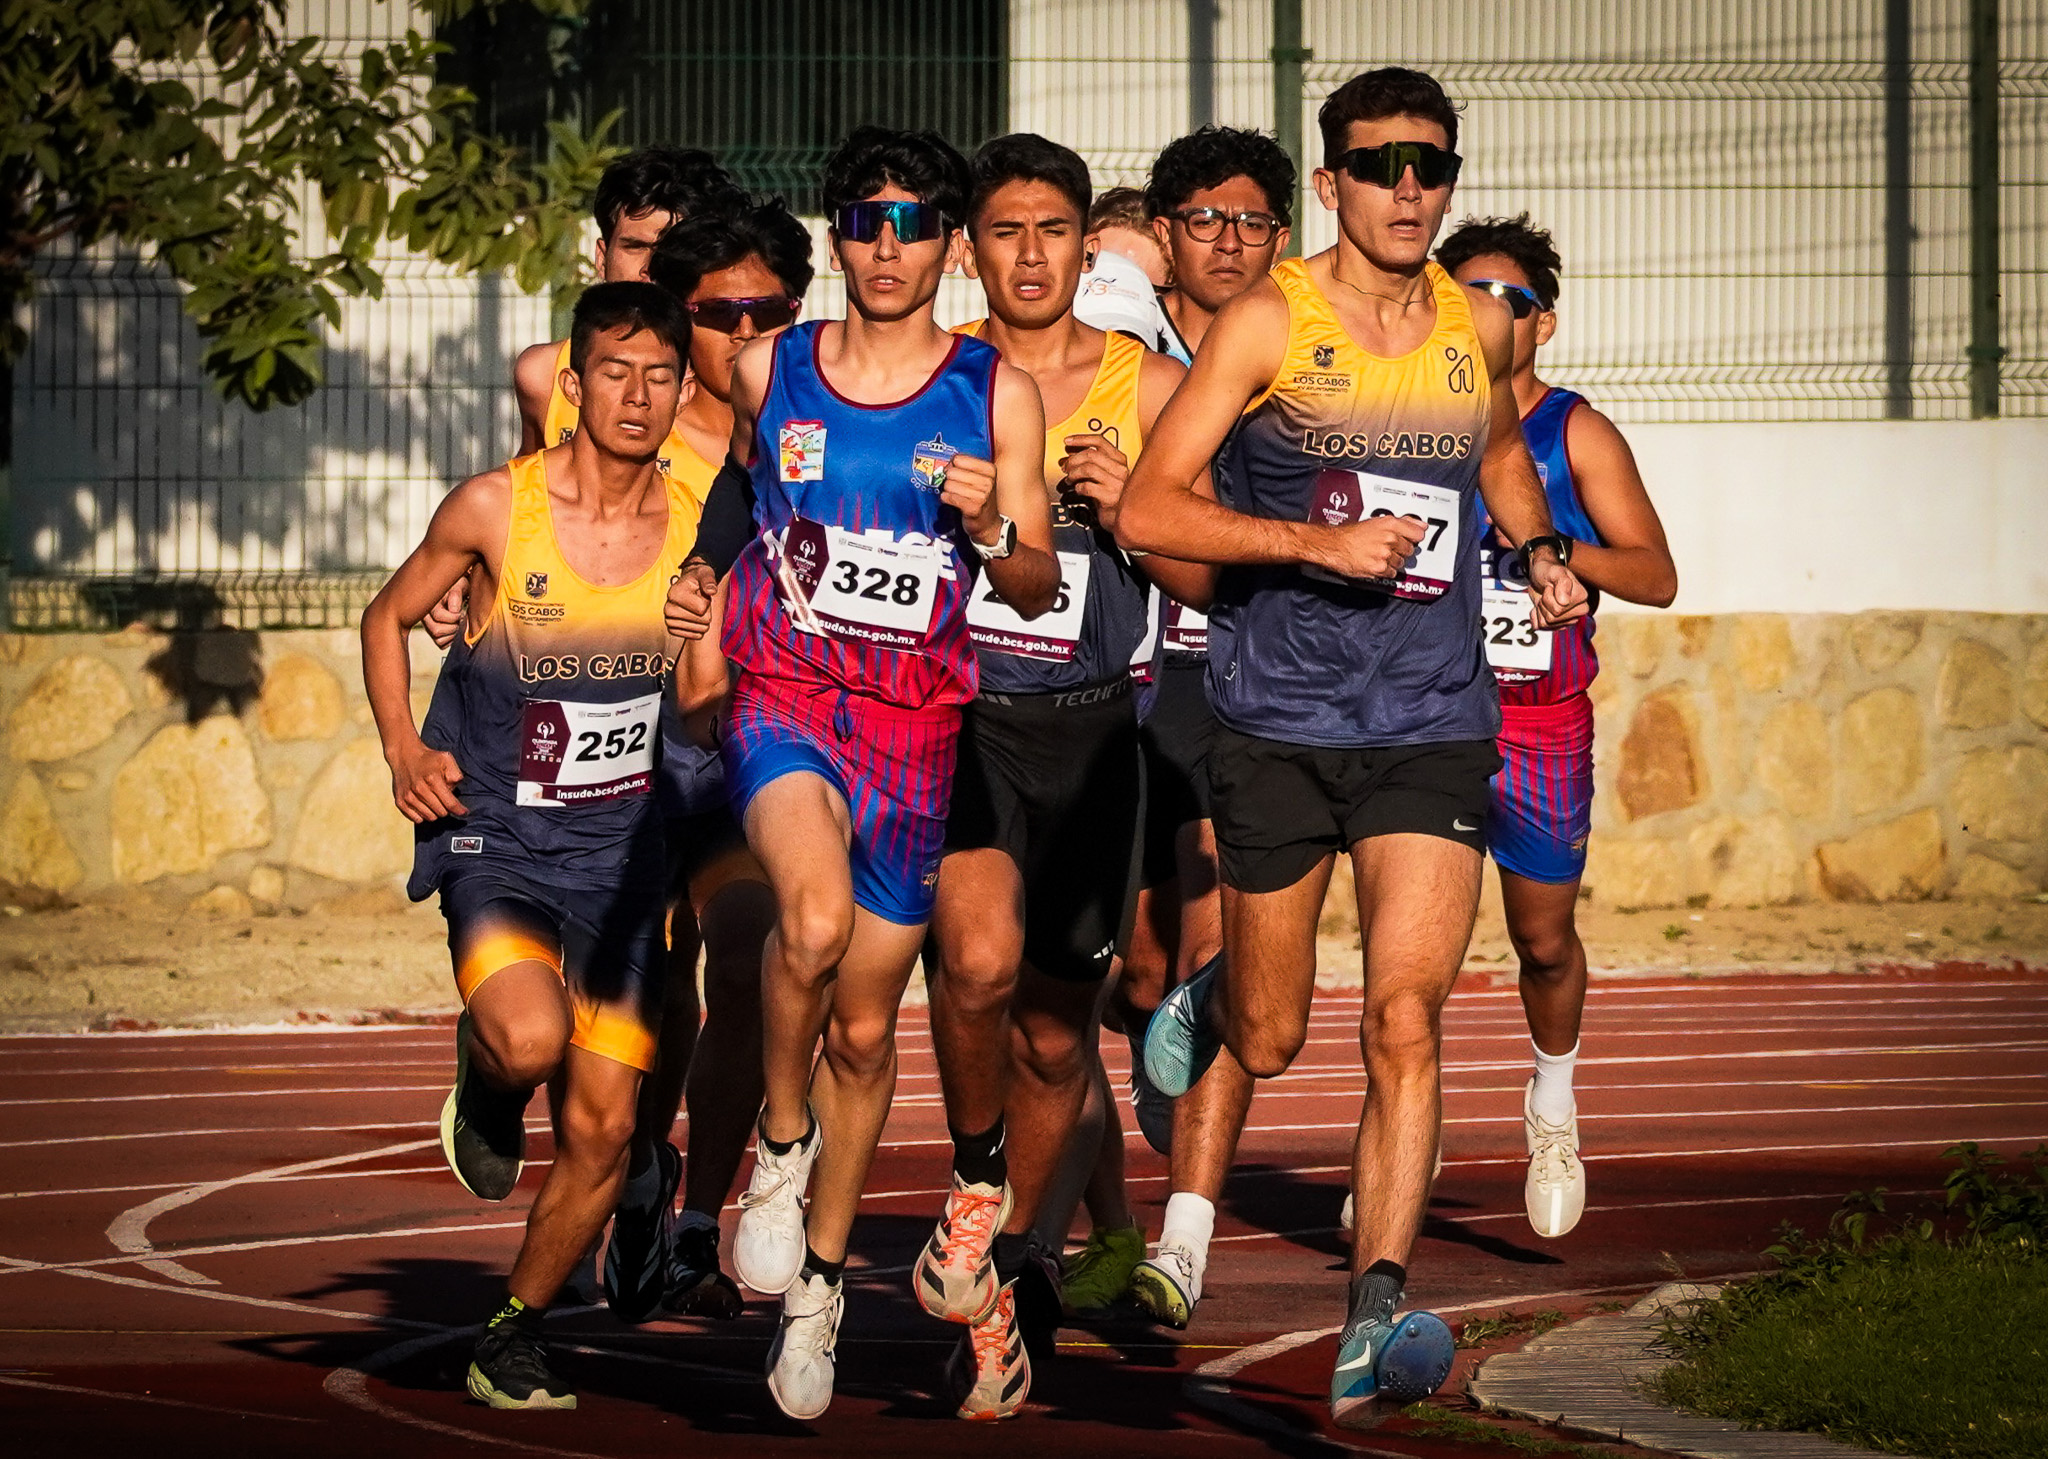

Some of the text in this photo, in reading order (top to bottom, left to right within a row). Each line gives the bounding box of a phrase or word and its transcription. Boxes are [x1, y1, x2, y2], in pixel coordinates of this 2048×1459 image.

[1293, 376, 1351, 387] LOS CABOS
[1302, 429, 1472, 460] LOS CABOS
[832, 560, 921, 606] 328
[508, 600, 526, 615] LOS
[527, 606, 565, 617] CABOS
[520, 654, 580, 683] LOS
[575, 722, 648, 762] 252
